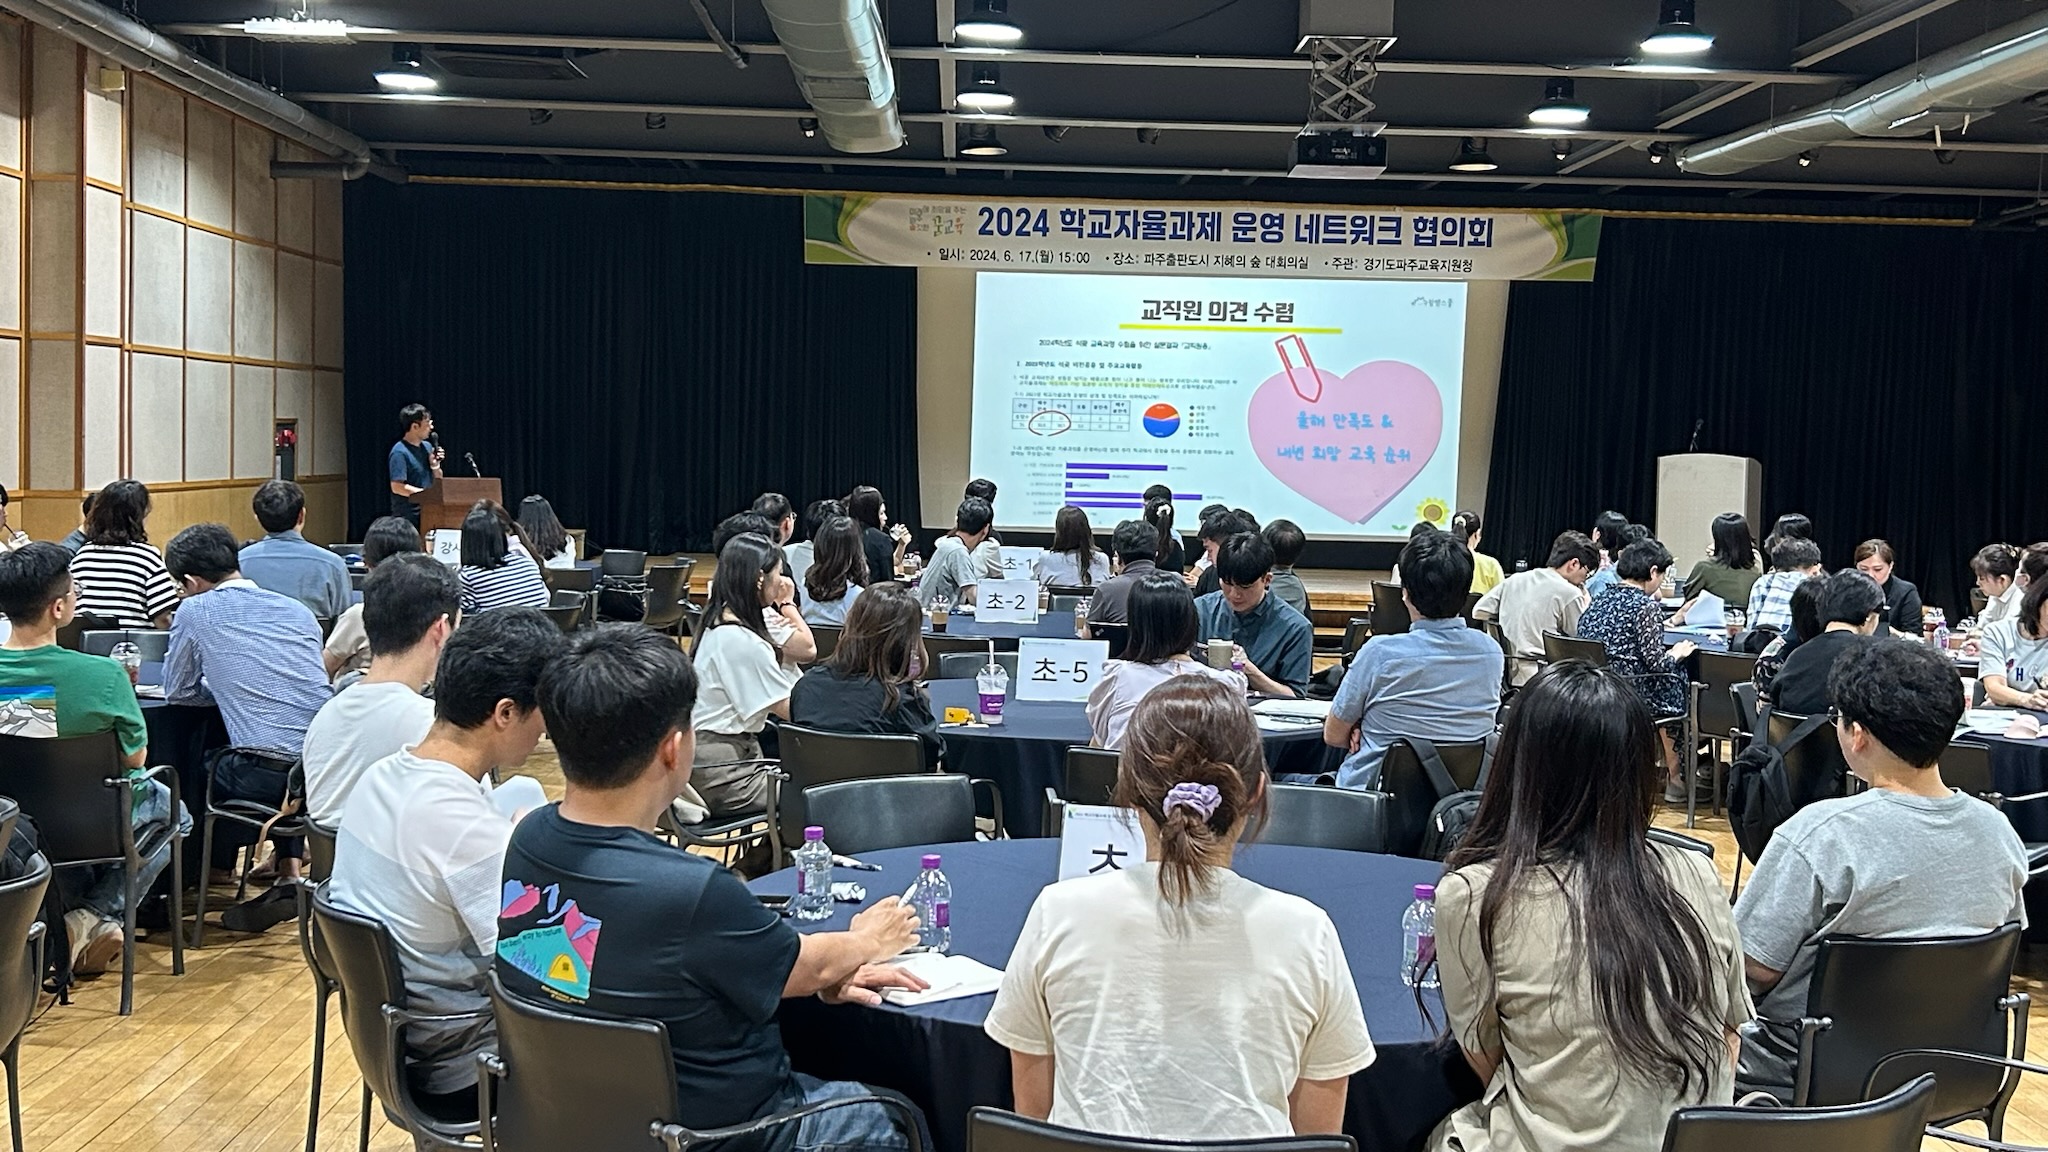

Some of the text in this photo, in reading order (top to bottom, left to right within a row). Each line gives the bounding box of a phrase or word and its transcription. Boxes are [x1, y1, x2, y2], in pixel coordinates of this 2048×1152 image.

[978, 206, 1494, 247] 2024 학교자율과제 운영 네트워크 협의회
[938, 248, 965, 261] 일시:
[970, 249, 999, 262] 2024.
[1003, 250, 1014, 262] 6.
[1059, 251, 1090, 264] 15:00
[1112, 252, 1139, 266] 장소:
[1143, 253, 1209, 267] 파주출판도시
[1213, 254, 1246, 268] 지혜의
[1249, 255, 1261, 269] 숲
[1265, 256, 1309, 270] 대회의실
[1331, 257, 1358, 270] 주관:
[1363, 258, 1473, 272] 경기도파주교육지원청
[1141, 299, 1294, 323] 교직원 의견 수렴
[1296, 410, 1325, 429] 올해
[1312, 445, 1341, 462] 희망
[1348, 445, 1376, 463] 교육
[1383, 446, 1411, 463] 순위
[1003, 557, 1032, 570] 초-1
[986, 592, 1026, 610] 초-2
[1031, 657, 1088, 683] 초-5
